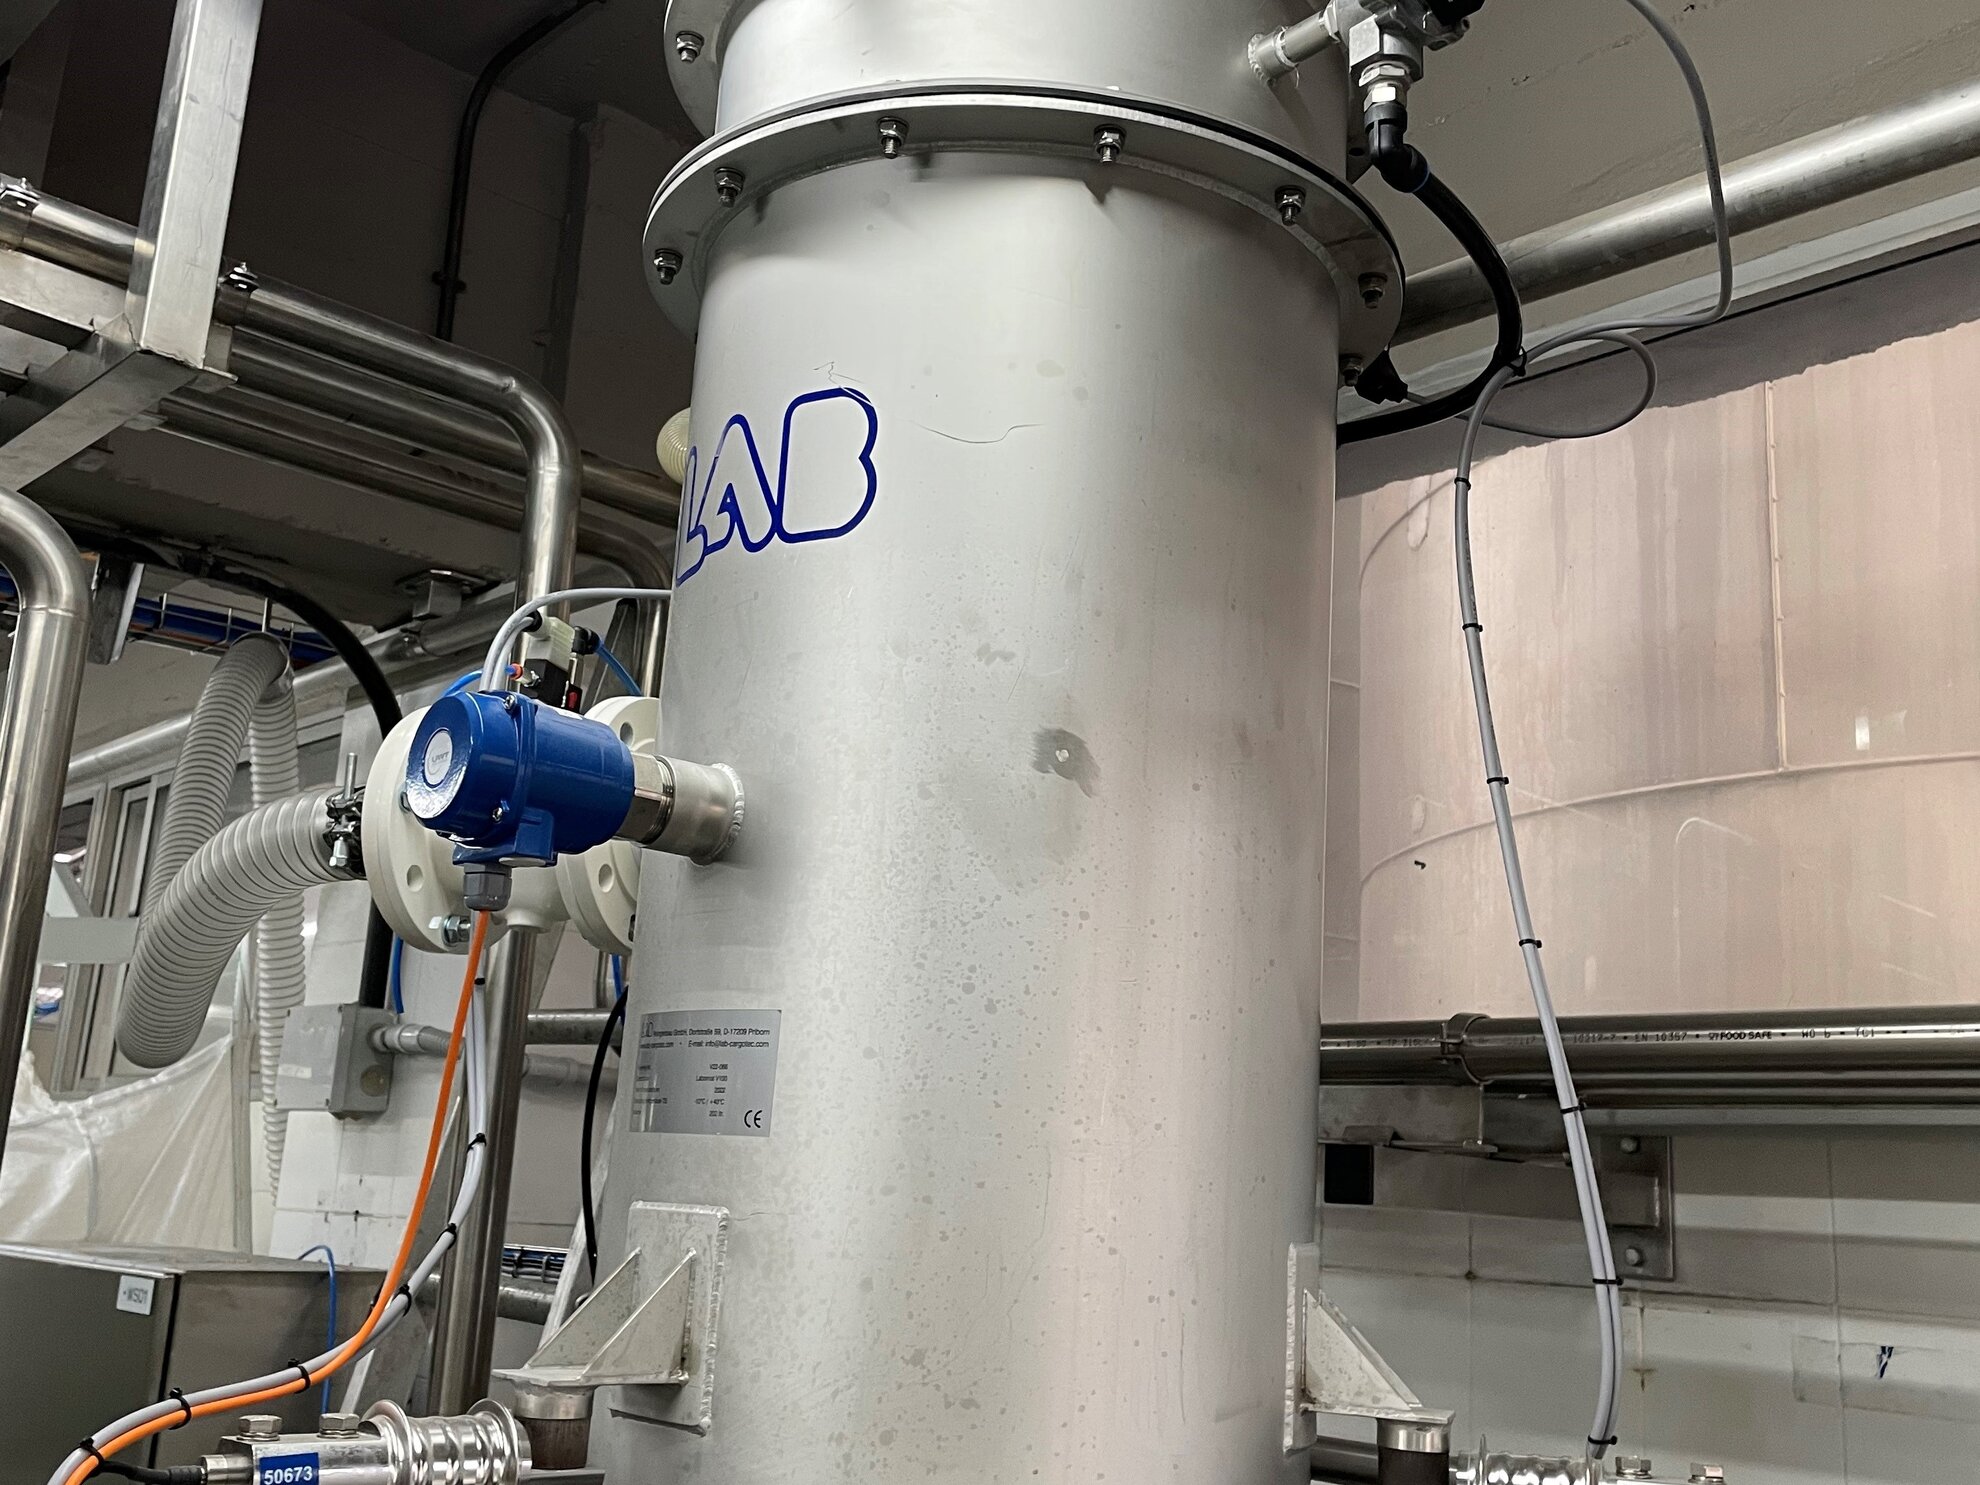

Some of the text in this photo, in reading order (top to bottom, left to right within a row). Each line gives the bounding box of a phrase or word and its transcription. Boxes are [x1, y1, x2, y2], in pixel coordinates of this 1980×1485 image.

[676, 387, 878, 587] LAB
[1720, 1031, 1746, 1040] FOOD
[1748, 1030, 1773, 1039] SAFE
[263, 1465, 313, 1485] 50673
